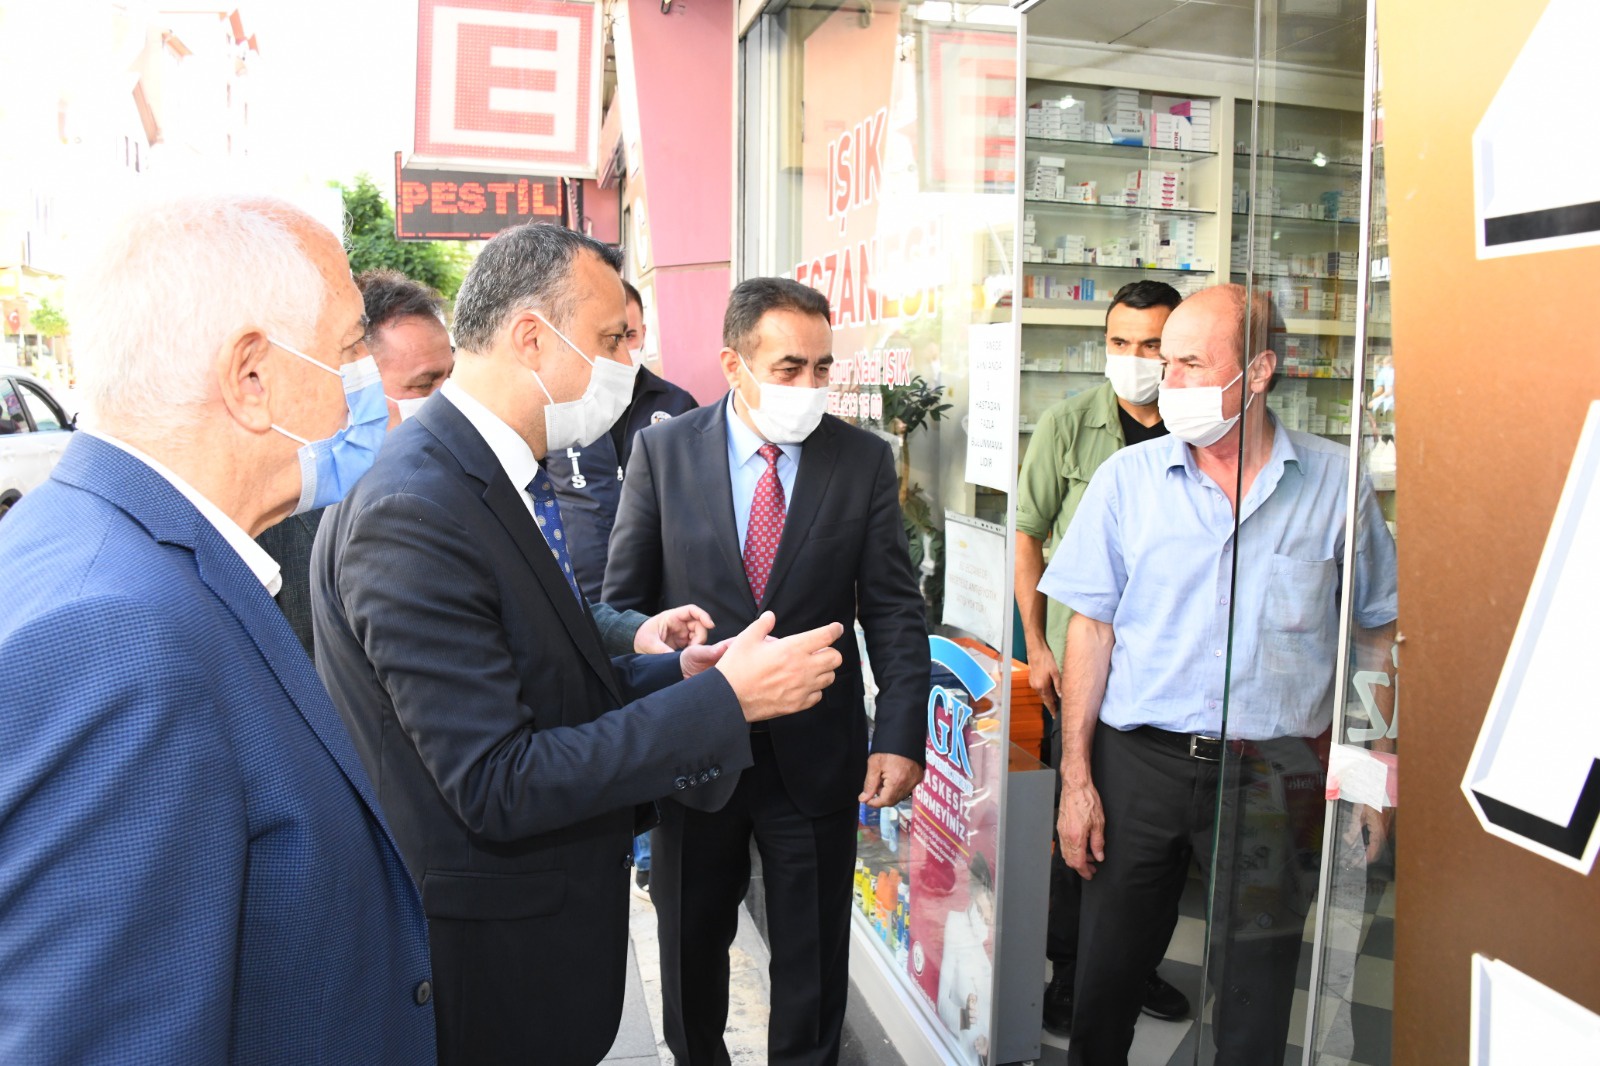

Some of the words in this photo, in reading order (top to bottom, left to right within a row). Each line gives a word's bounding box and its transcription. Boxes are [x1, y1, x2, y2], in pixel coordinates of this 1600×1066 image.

[453, 22, 558, 136] E
[401, 178, 557, 215] PESTİL
[827, 107, 888, 235] IŞIK
[882, 348, 911, 390] IŞIK
[923, 768, 971, 823] ASKESİZ
